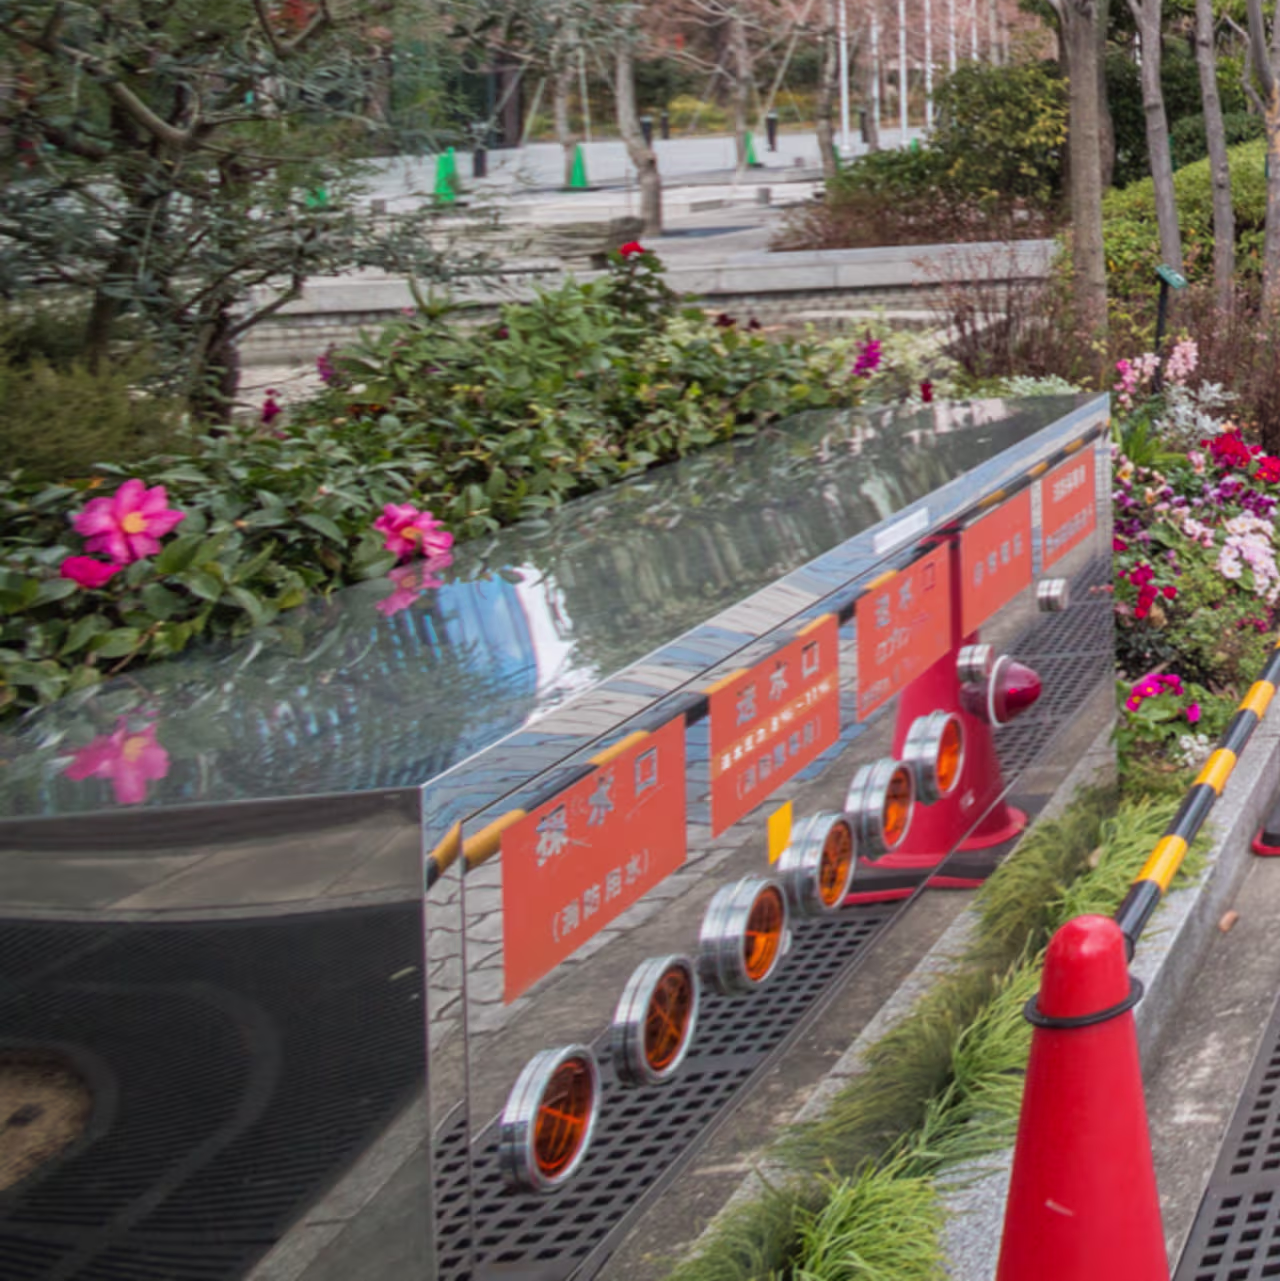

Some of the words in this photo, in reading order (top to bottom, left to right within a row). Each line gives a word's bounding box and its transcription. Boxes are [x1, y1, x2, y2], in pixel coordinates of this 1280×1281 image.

[736, 640, 820, 727] 送水口
[534, 746, 658, 867] 採水口
